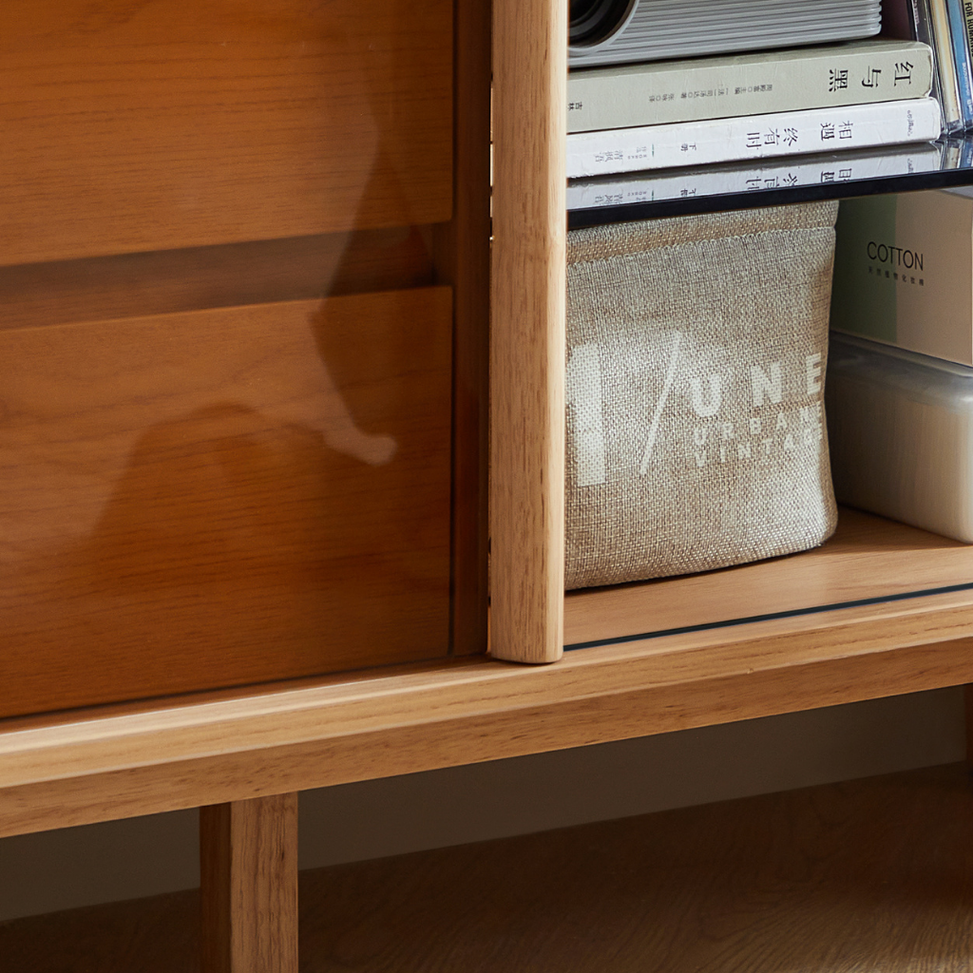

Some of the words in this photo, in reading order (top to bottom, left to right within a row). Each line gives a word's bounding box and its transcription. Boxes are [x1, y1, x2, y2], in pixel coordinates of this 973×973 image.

[965, 2, 973, 17] FOR
[828, 61, 914, 92] 红与黑
[746, 127, 798, 149] 终有时
[820, 120, 853, 141] 相遇
[867, 241, 923, 271] COTTON
